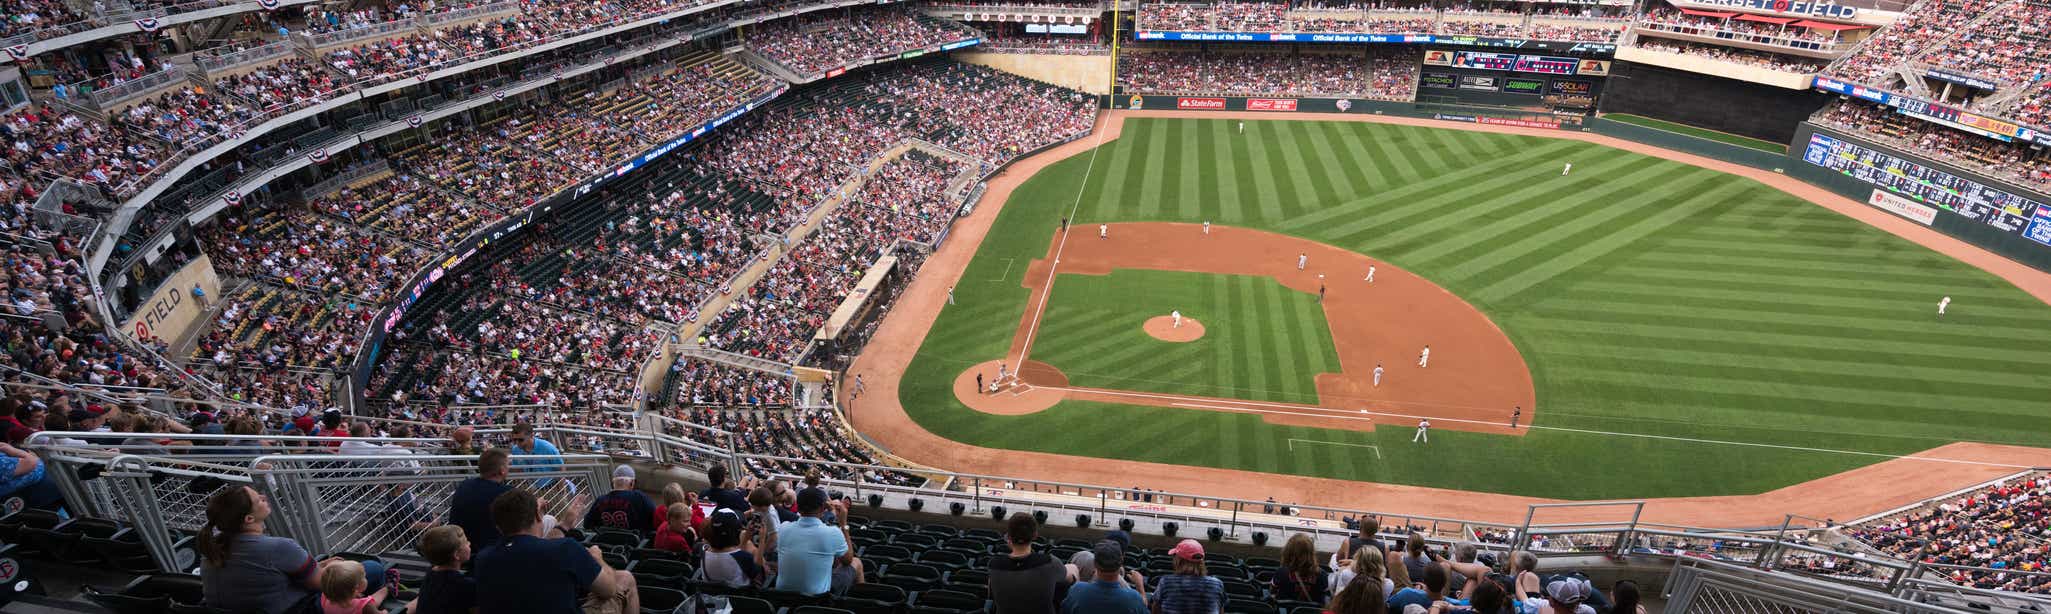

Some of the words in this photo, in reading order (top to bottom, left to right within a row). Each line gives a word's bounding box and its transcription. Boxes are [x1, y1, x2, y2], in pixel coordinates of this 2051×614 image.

[1792, 2, 1856, 18] FIELD
[1506, 81, 1541, 90] SUBWAY
[1817, 78, 1846, 91] usbank
[1852, 86, 1883, 100] usbank
[644, 150, 658, 161] Official
[1883, 197, 1906, 209] UNITED
[145, 288, 181, 331] FIELD
